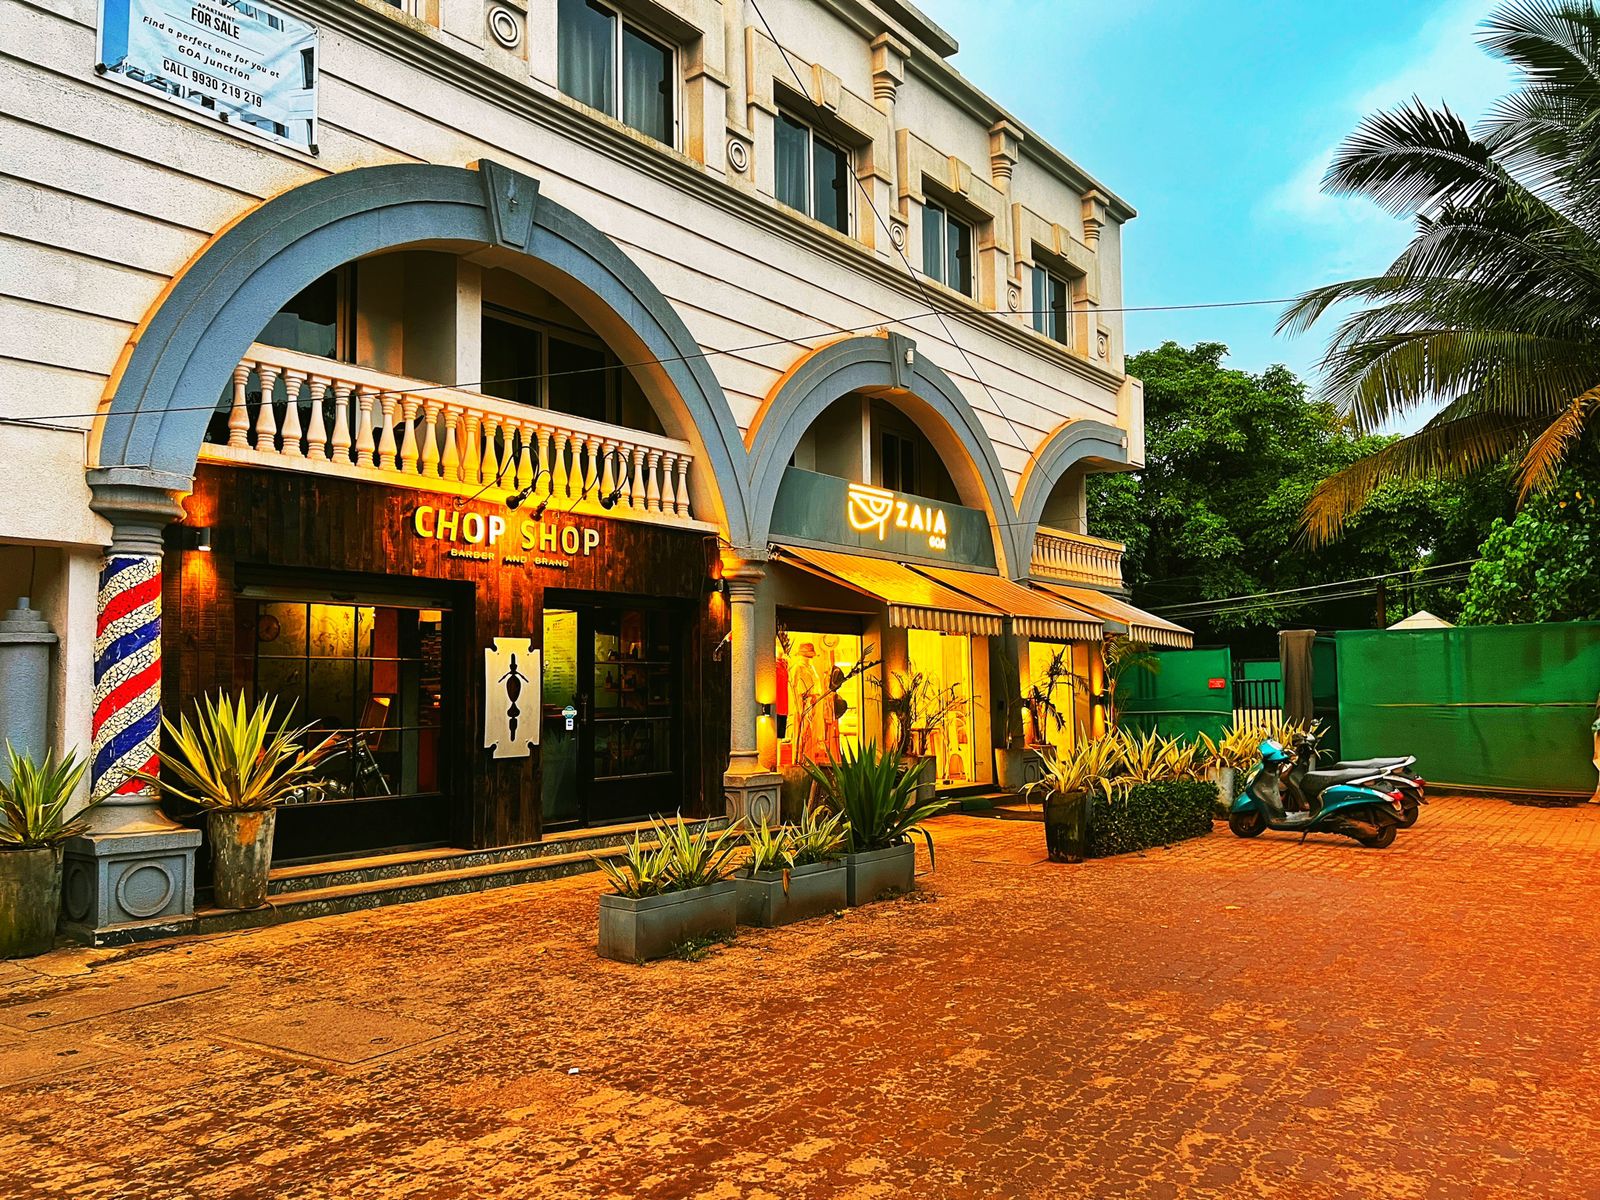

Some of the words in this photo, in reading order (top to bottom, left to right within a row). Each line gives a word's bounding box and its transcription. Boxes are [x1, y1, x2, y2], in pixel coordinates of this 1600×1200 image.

[191, 6, 212, 28] FOR
[213, 17, 240, 40] SALE
[197, 2, 236, 23] APARTMENT
[142, 16, 165, 30] Find
[176, 31, 212, 50] perfect
[215, 47, 232, 59] one
[234, 54, 249, 65] for
[250, 62, 267, 73] you
[269, 70, 280, 79] at
[178, 45, 201, 61] GOA
[203, 55, 250, 81] Junction
[163, 59, 189, 80] CALL
[191, 70, 218, 91] 9930
[221, 82, 241, 99] 219
[244, 91, 262, 108] 219
[414, 504, 506, 546] CHOP
[519, 519, 600, 557] SHOP
[895, 501, 947, 535] ZAIA
[450, 548, 496, 560] BARBER
[504, 554, 528, 563] AND
[534, 556, 570, 568] BRAND
